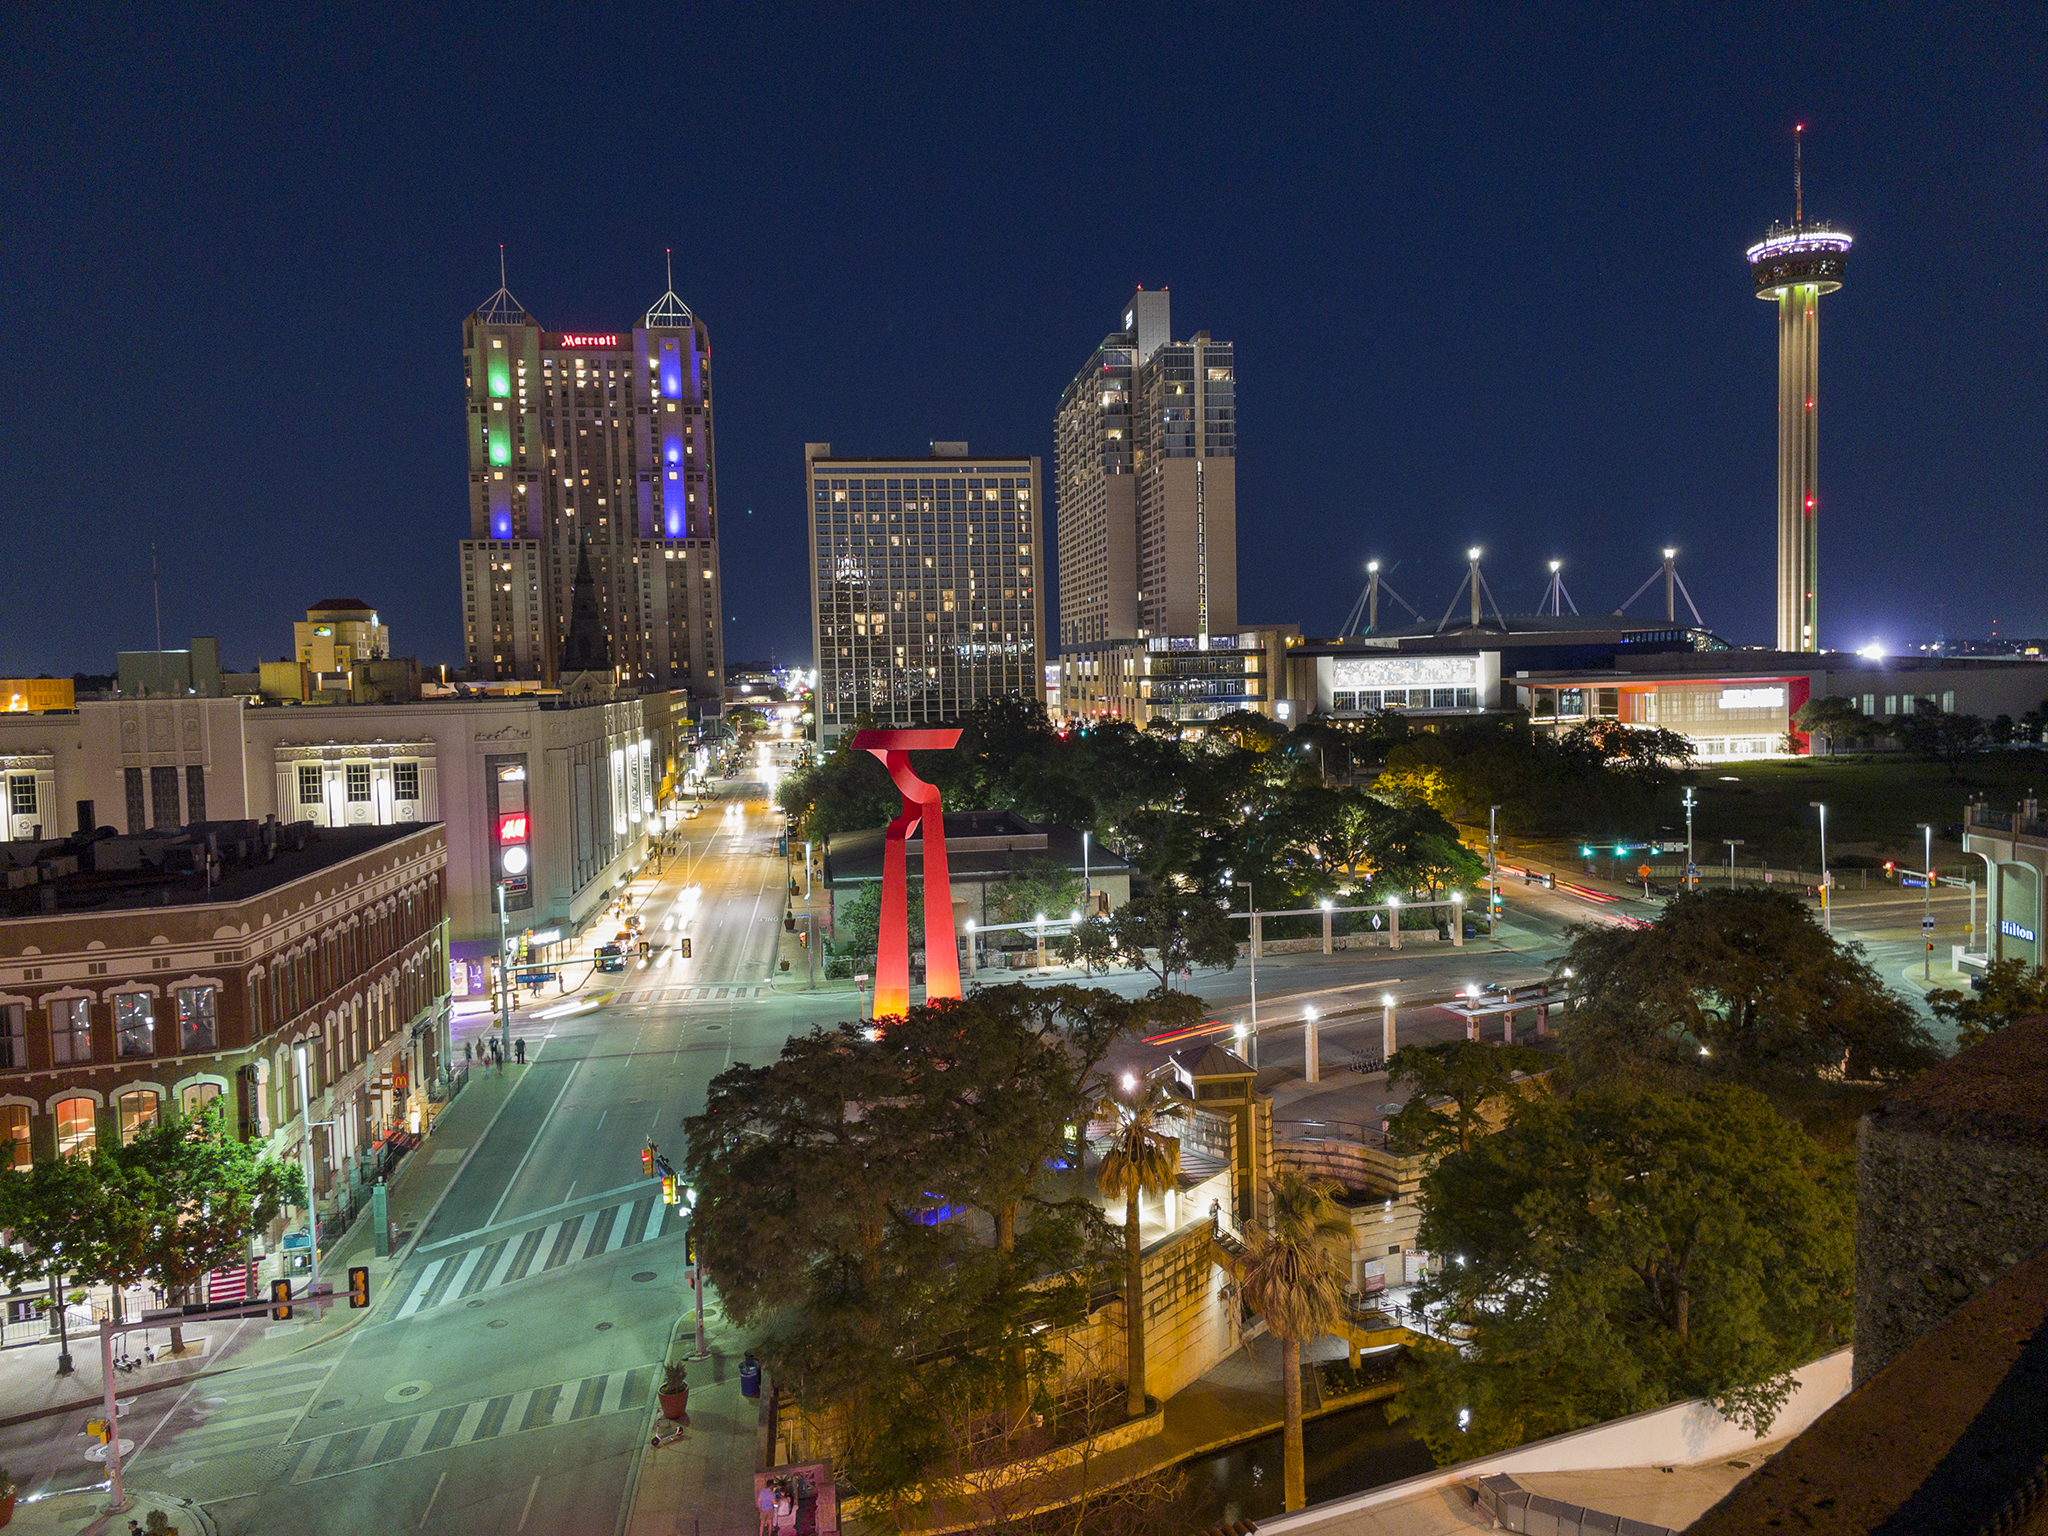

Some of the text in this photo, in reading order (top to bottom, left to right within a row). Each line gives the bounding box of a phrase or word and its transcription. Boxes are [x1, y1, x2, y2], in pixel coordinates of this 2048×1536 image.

[561, 334, 617, 347] Marriott
[631, 785, 639, 814] IMAX
[2001, 920, 2034, 941] Hilton
